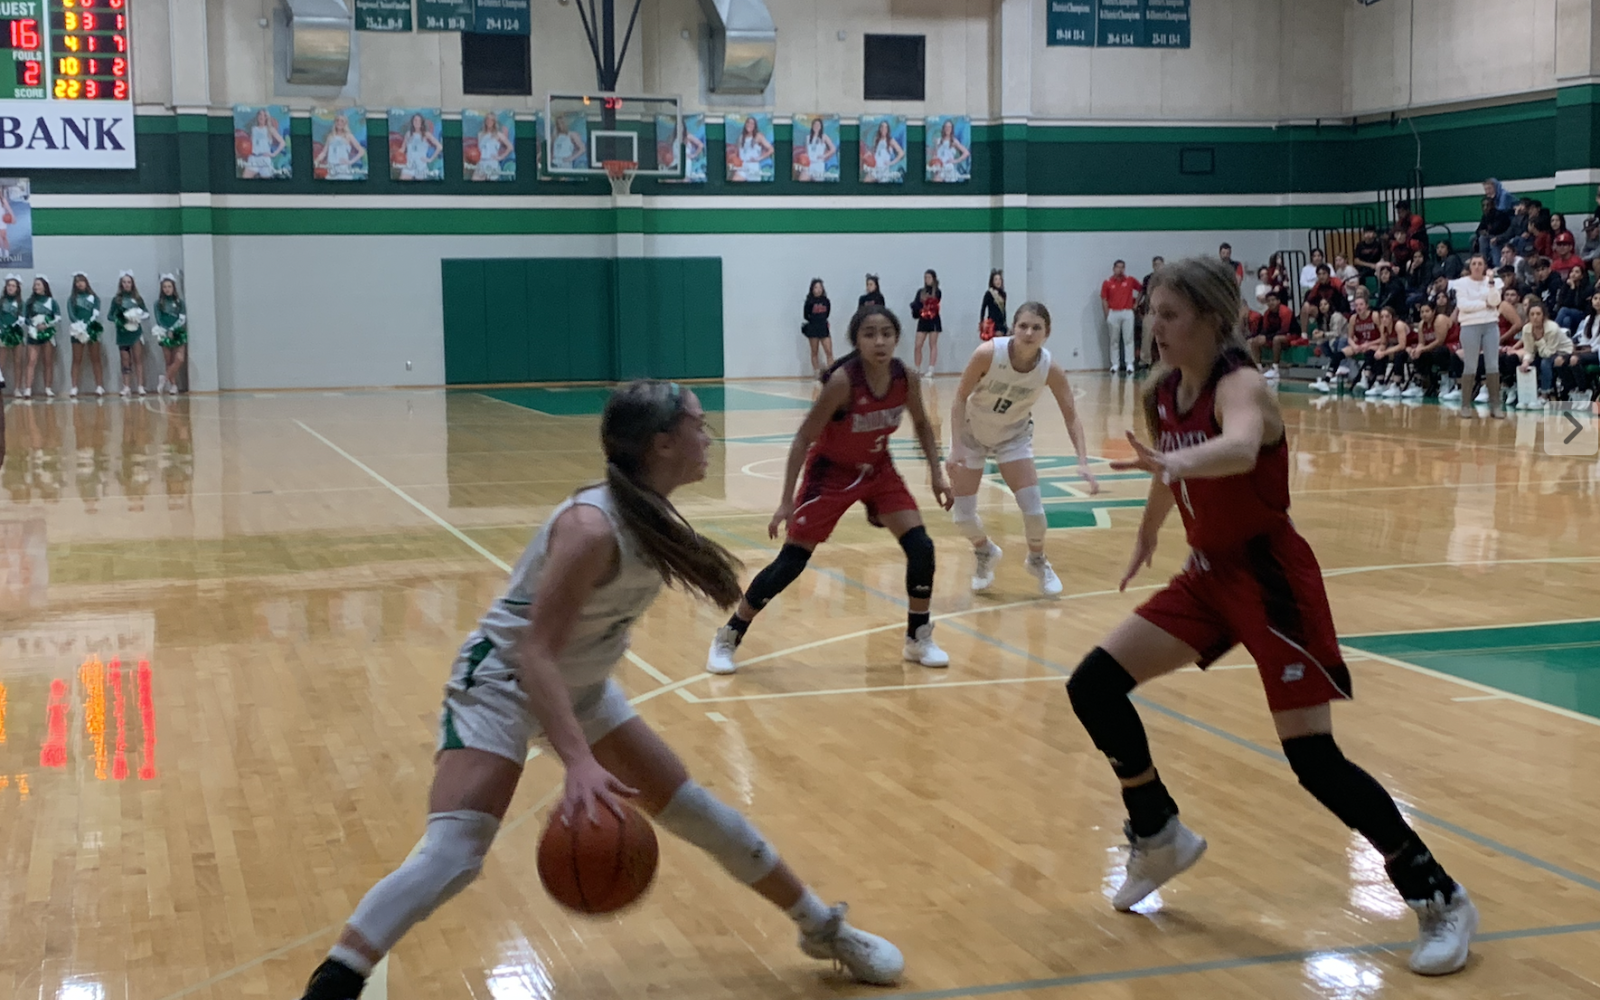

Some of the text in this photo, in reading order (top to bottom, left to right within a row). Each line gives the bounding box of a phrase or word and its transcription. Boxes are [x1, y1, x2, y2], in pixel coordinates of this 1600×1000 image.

[0, 3, 36, 16] UEST
[65, 11, 124, 31] 3 3 1
[11, 19, 40, 49] 16
[64, 34, 125, 52] 4 1 7
[13, 51, 42, 61] FOULS
[59, 56, 125, 76] 10 1 2
[24, 60, 40, 86] 2
[14, 88, 44, 98] SCORE
[54, 79, 126, 99] 22 3 2
[0, 116, 126, 151] BANK
[993, 397, 1013, 414] 13
